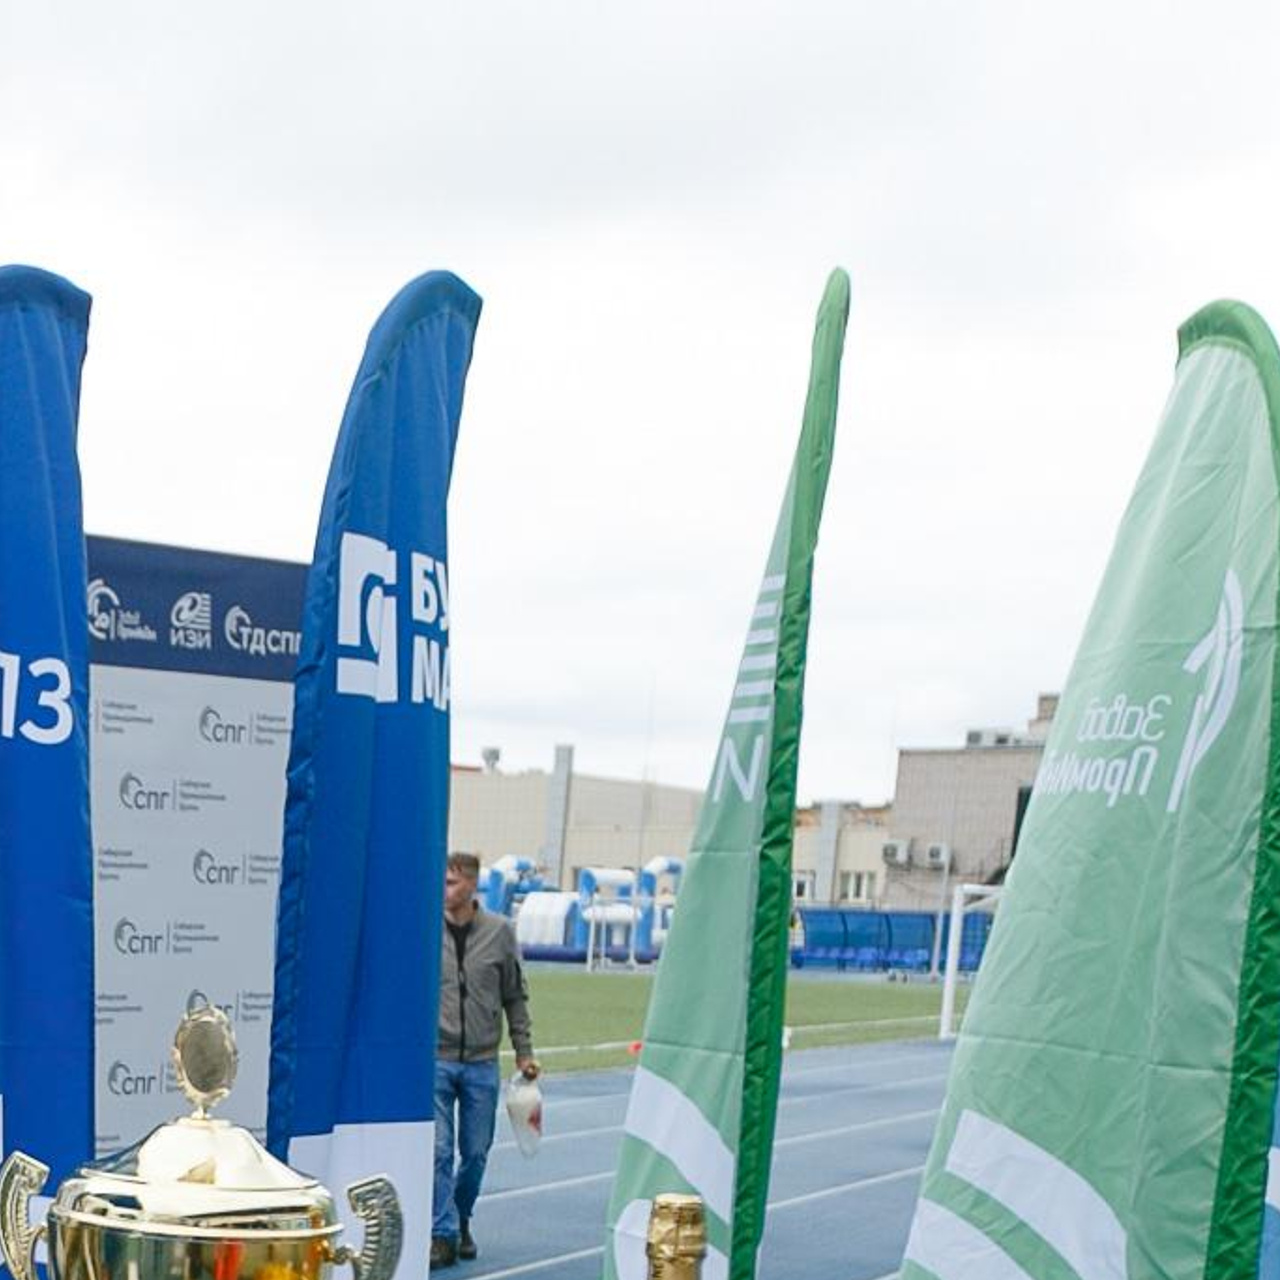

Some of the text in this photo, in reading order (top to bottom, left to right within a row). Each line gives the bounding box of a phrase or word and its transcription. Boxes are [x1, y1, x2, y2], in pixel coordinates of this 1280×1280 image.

[170, 628, 212, 649] ИЭИ
[212, 722, 246, 744] СПГ
[134, 788, 170, 811] СПГ
[206, 863, 239, 885] СПГ
[128, 934, 163, 955] СПГ
